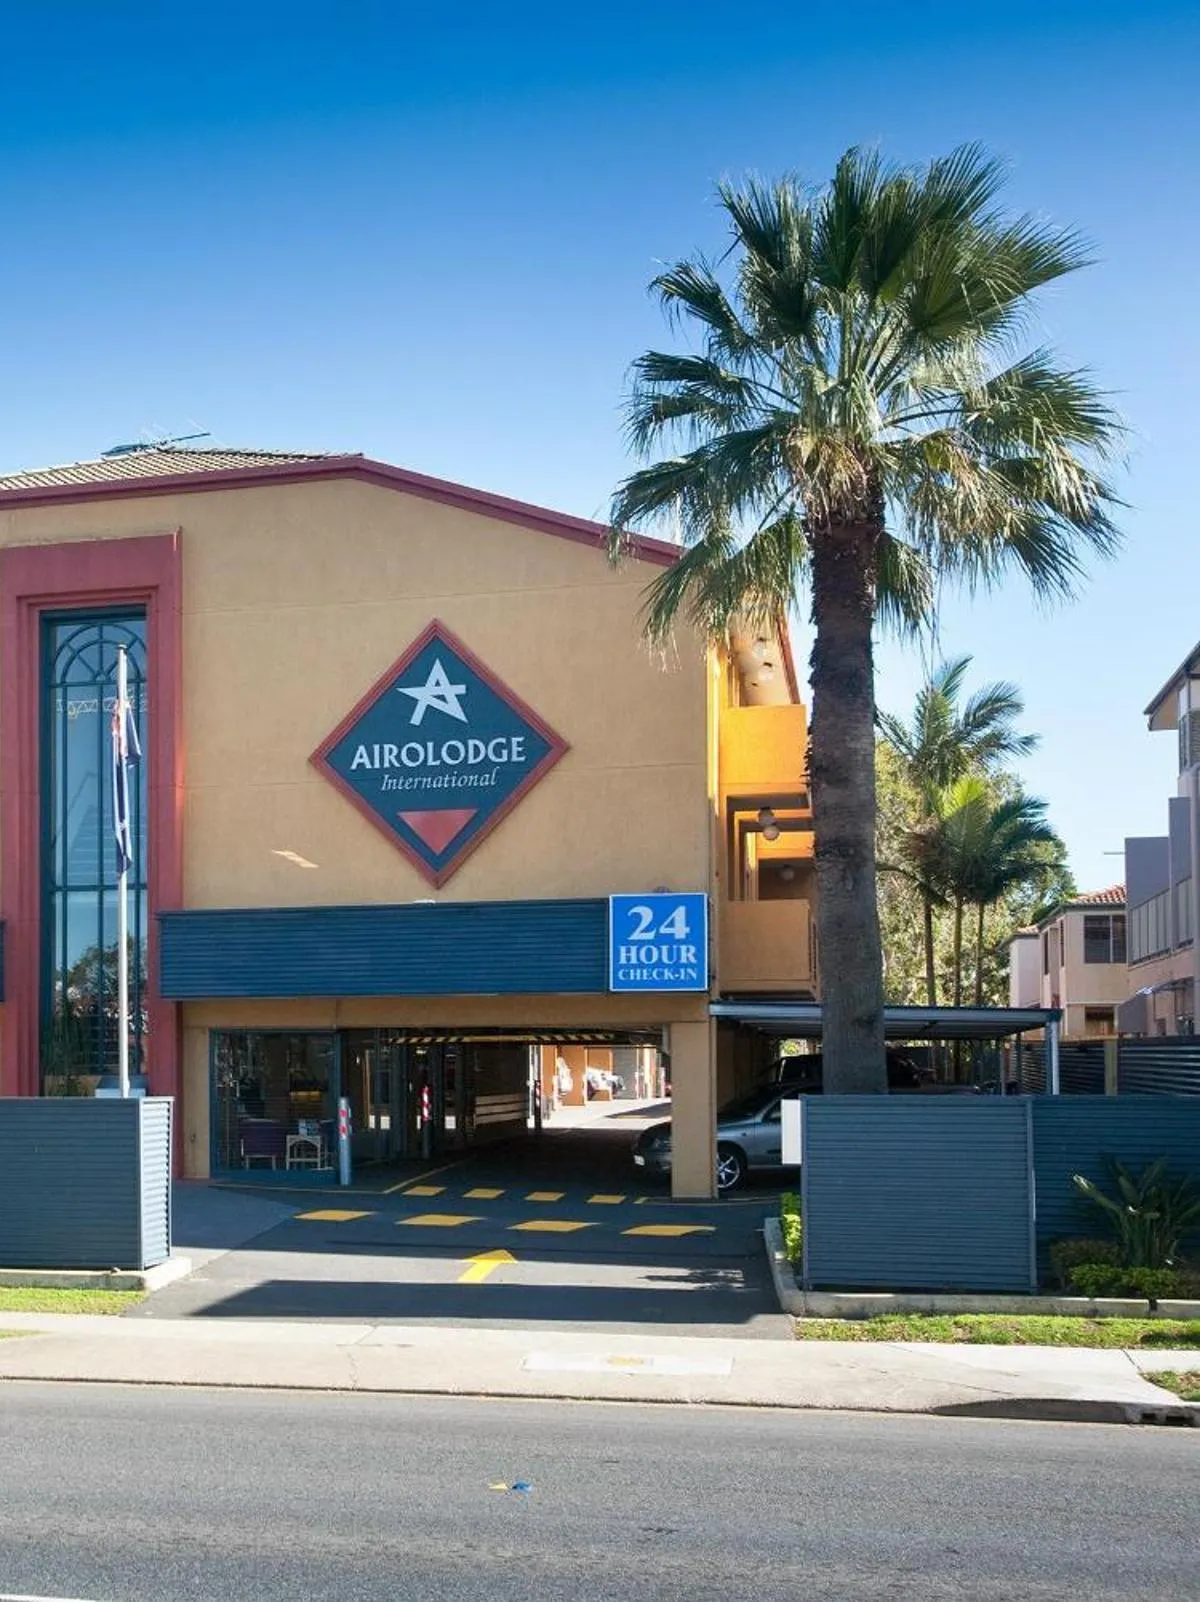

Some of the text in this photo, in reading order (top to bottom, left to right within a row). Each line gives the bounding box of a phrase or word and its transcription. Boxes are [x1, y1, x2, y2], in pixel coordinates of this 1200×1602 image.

[350, 736, 526, 770] AIROLODGE
[381, 766, 500, 791] International
[627, 905, 690, 940] 24
[618, 944, 697, 965] HOUR
[618, 968, 697, 981] CHECK-IN
